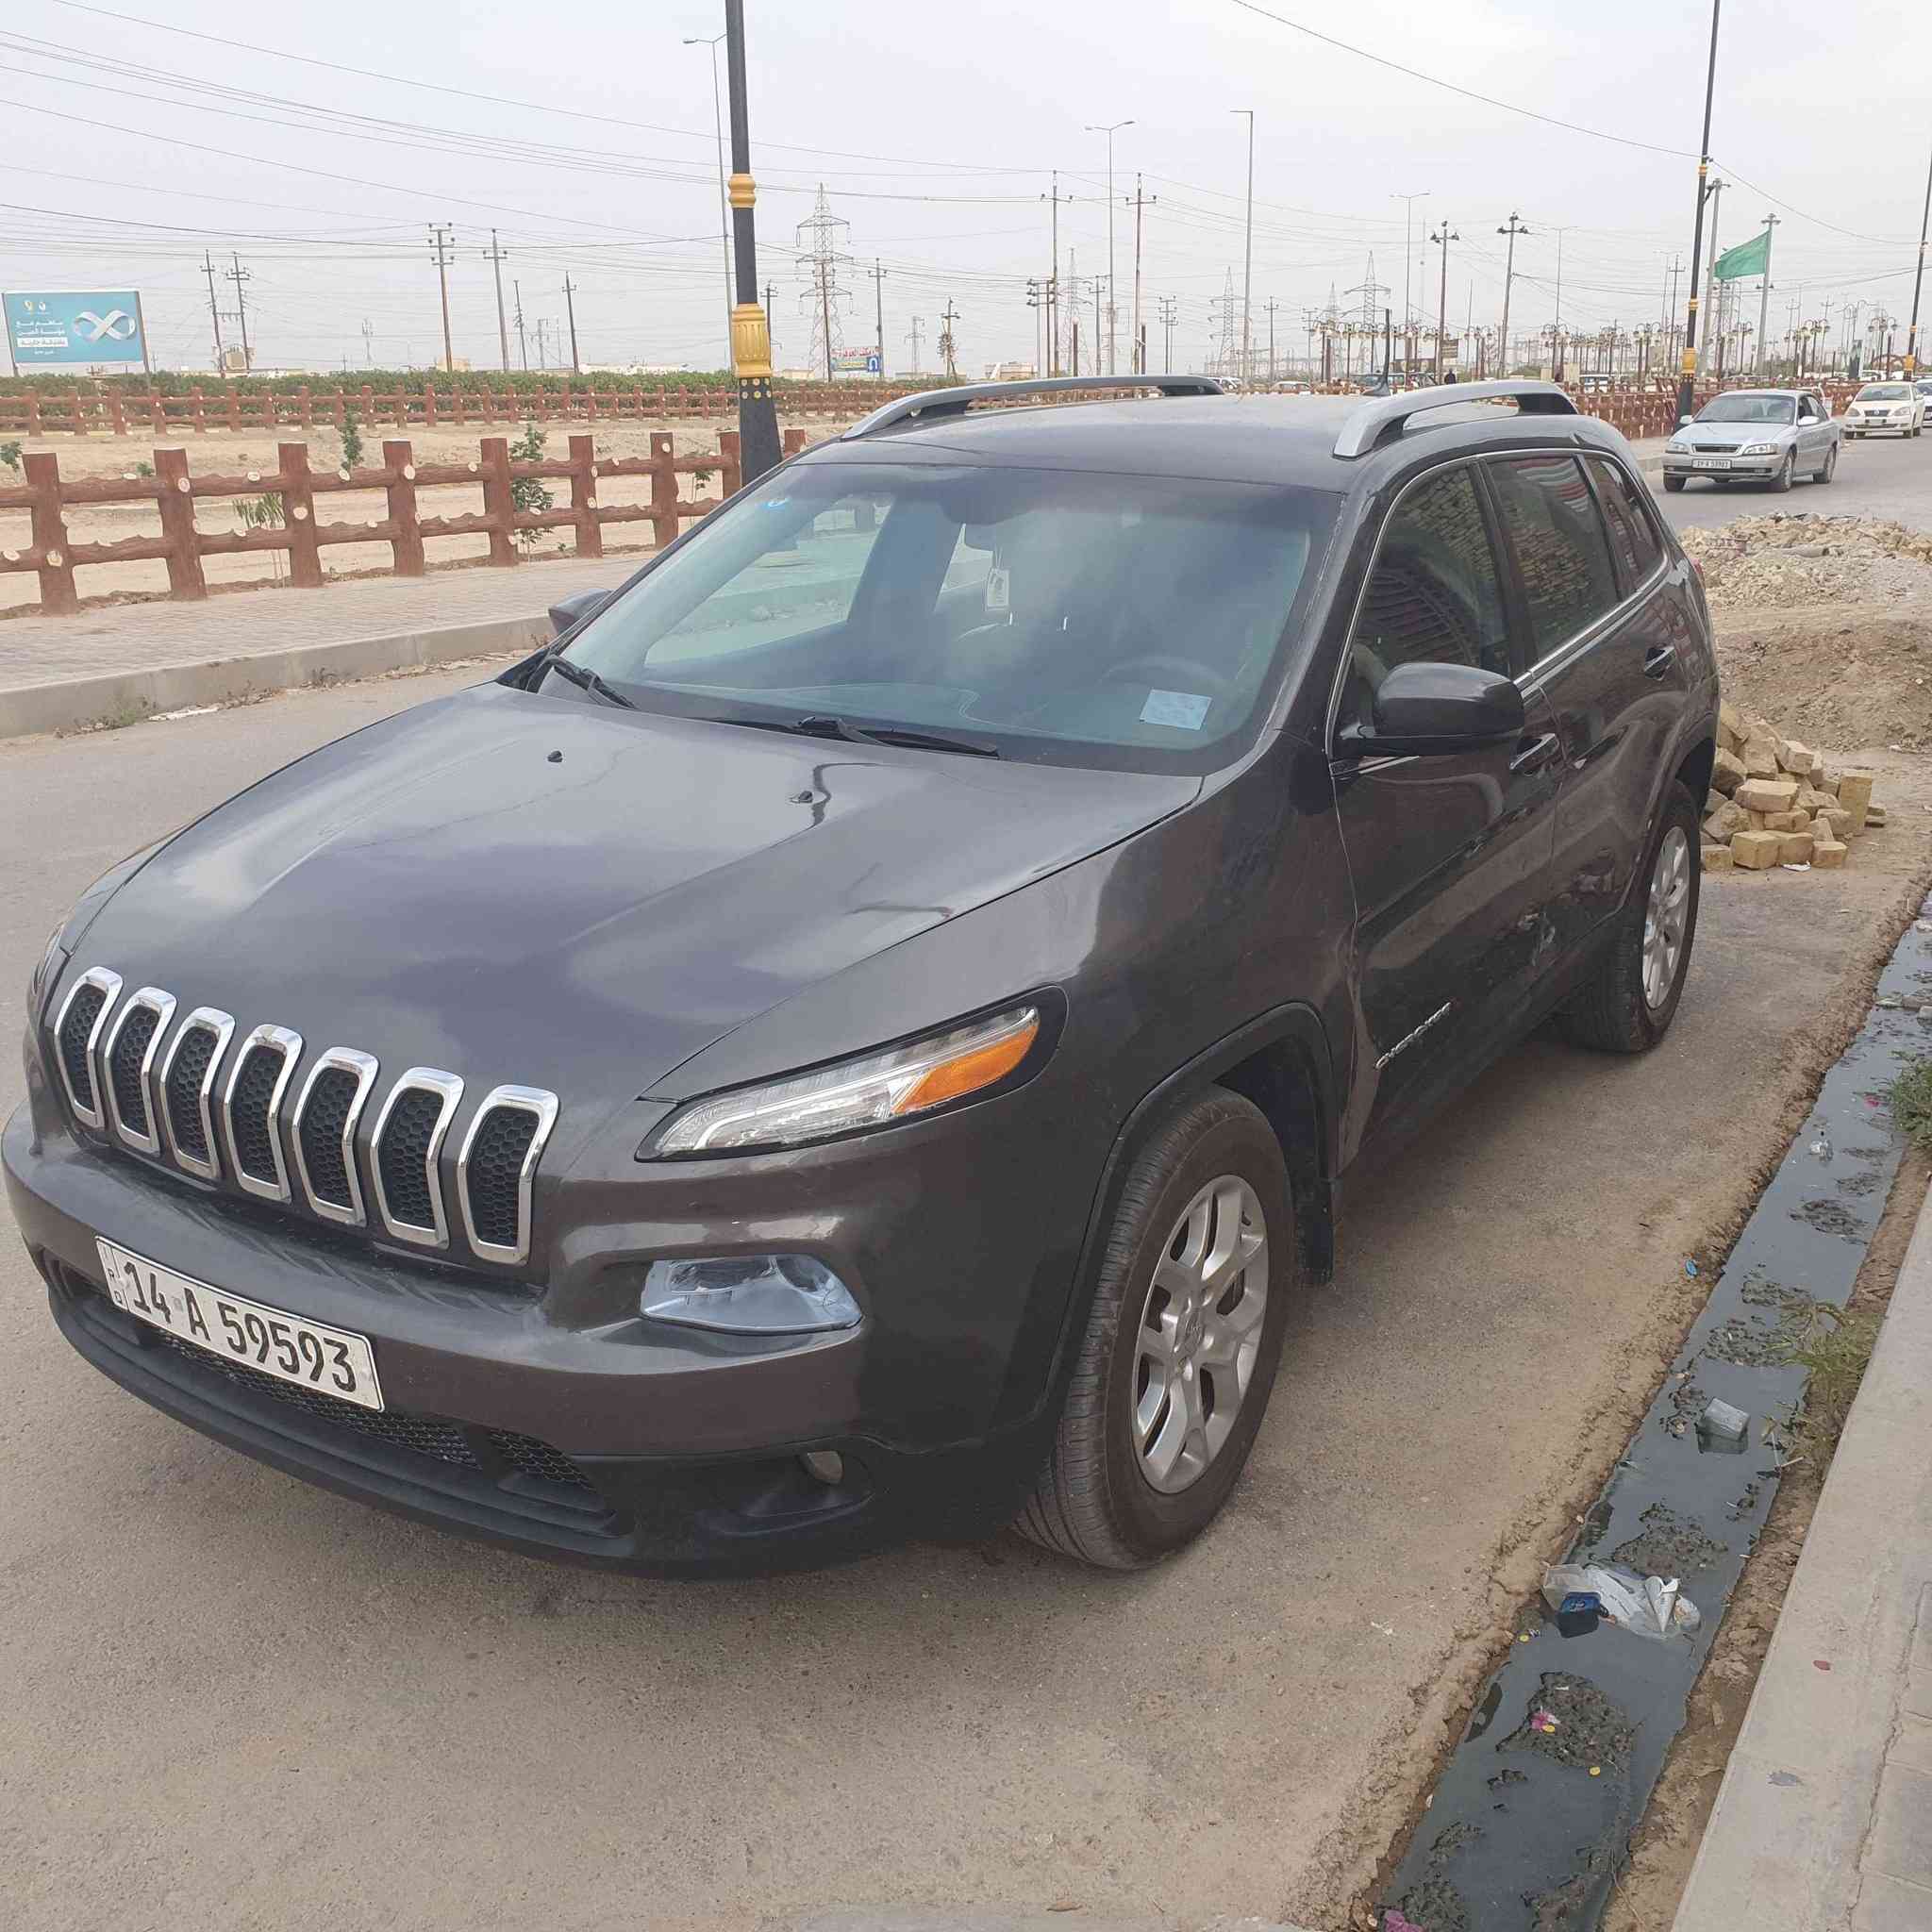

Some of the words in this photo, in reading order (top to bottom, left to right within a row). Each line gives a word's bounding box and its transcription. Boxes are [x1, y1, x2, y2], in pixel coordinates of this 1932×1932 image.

[124, 1261, 172, 1324] 14
[184, 1287, 211, 1341] A
[216, 1300, 358, 1392] 59593
